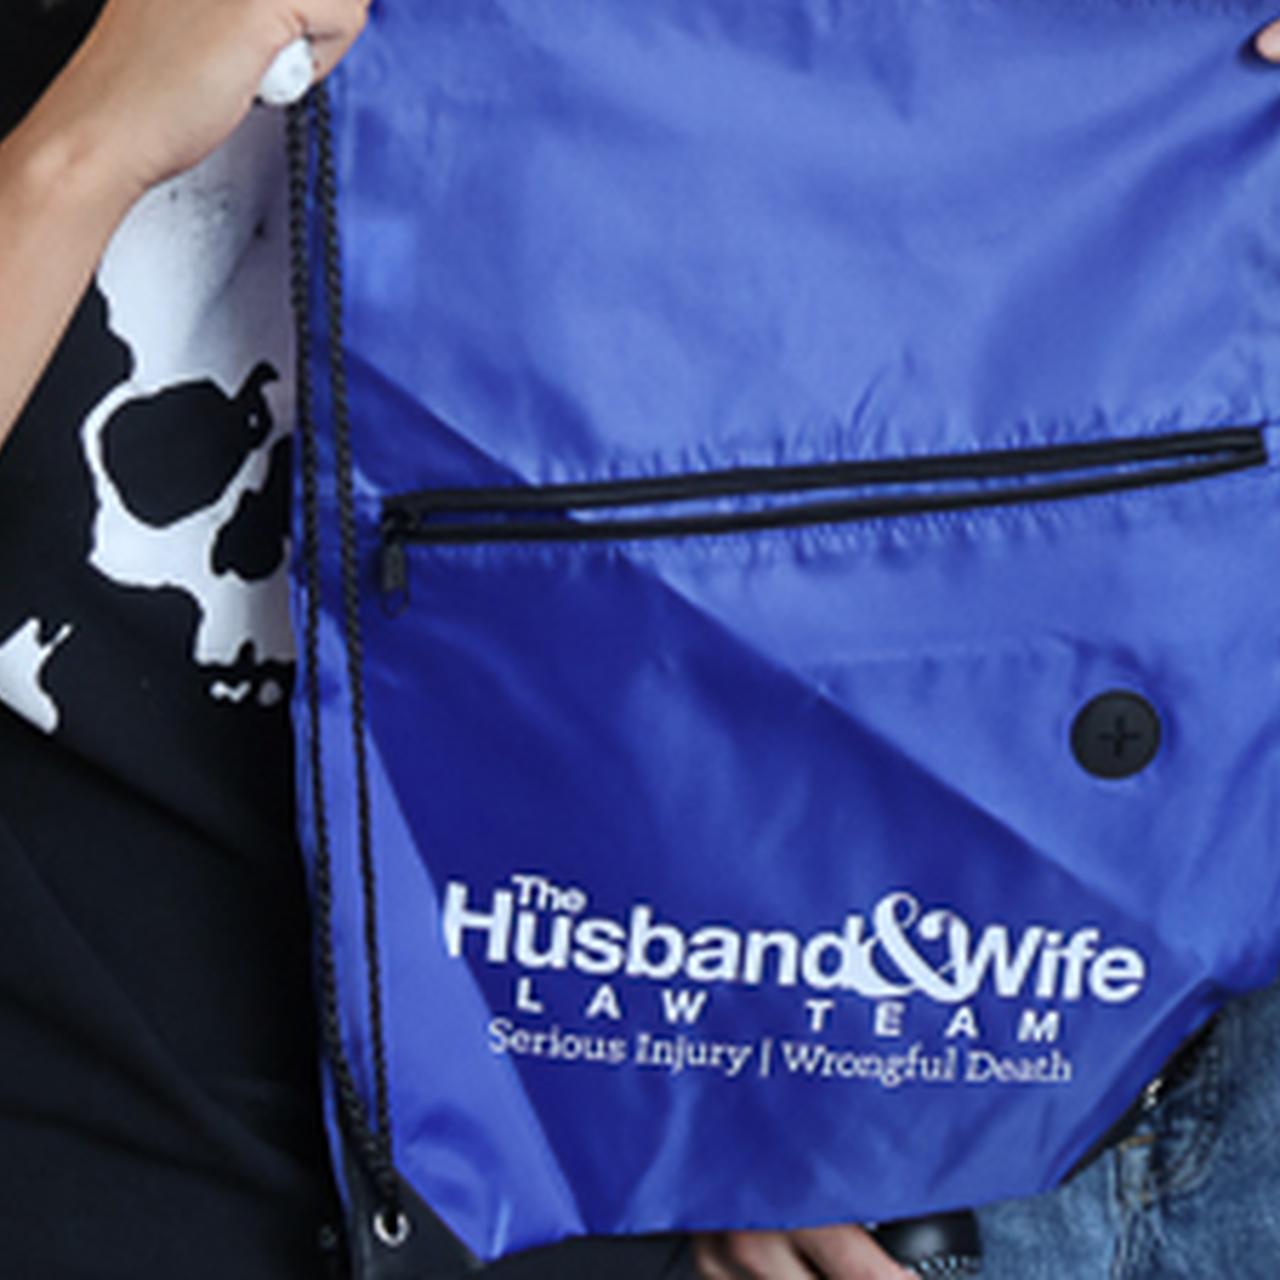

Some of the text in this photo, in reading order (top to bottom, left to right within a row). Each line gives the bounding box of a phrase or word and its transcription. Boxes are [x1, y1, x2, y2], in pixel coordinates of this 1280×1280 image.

[512, 874, 587, 913] The
[516, 976, 1060, 1043] LAW TEAM
[486, 1017, 627, 1064] Serious
[635, 1033, 752, 1077] Injury
[781, 1043, 957, 1088] Wrongful
[965, 1049, 1073, 1083] Death
